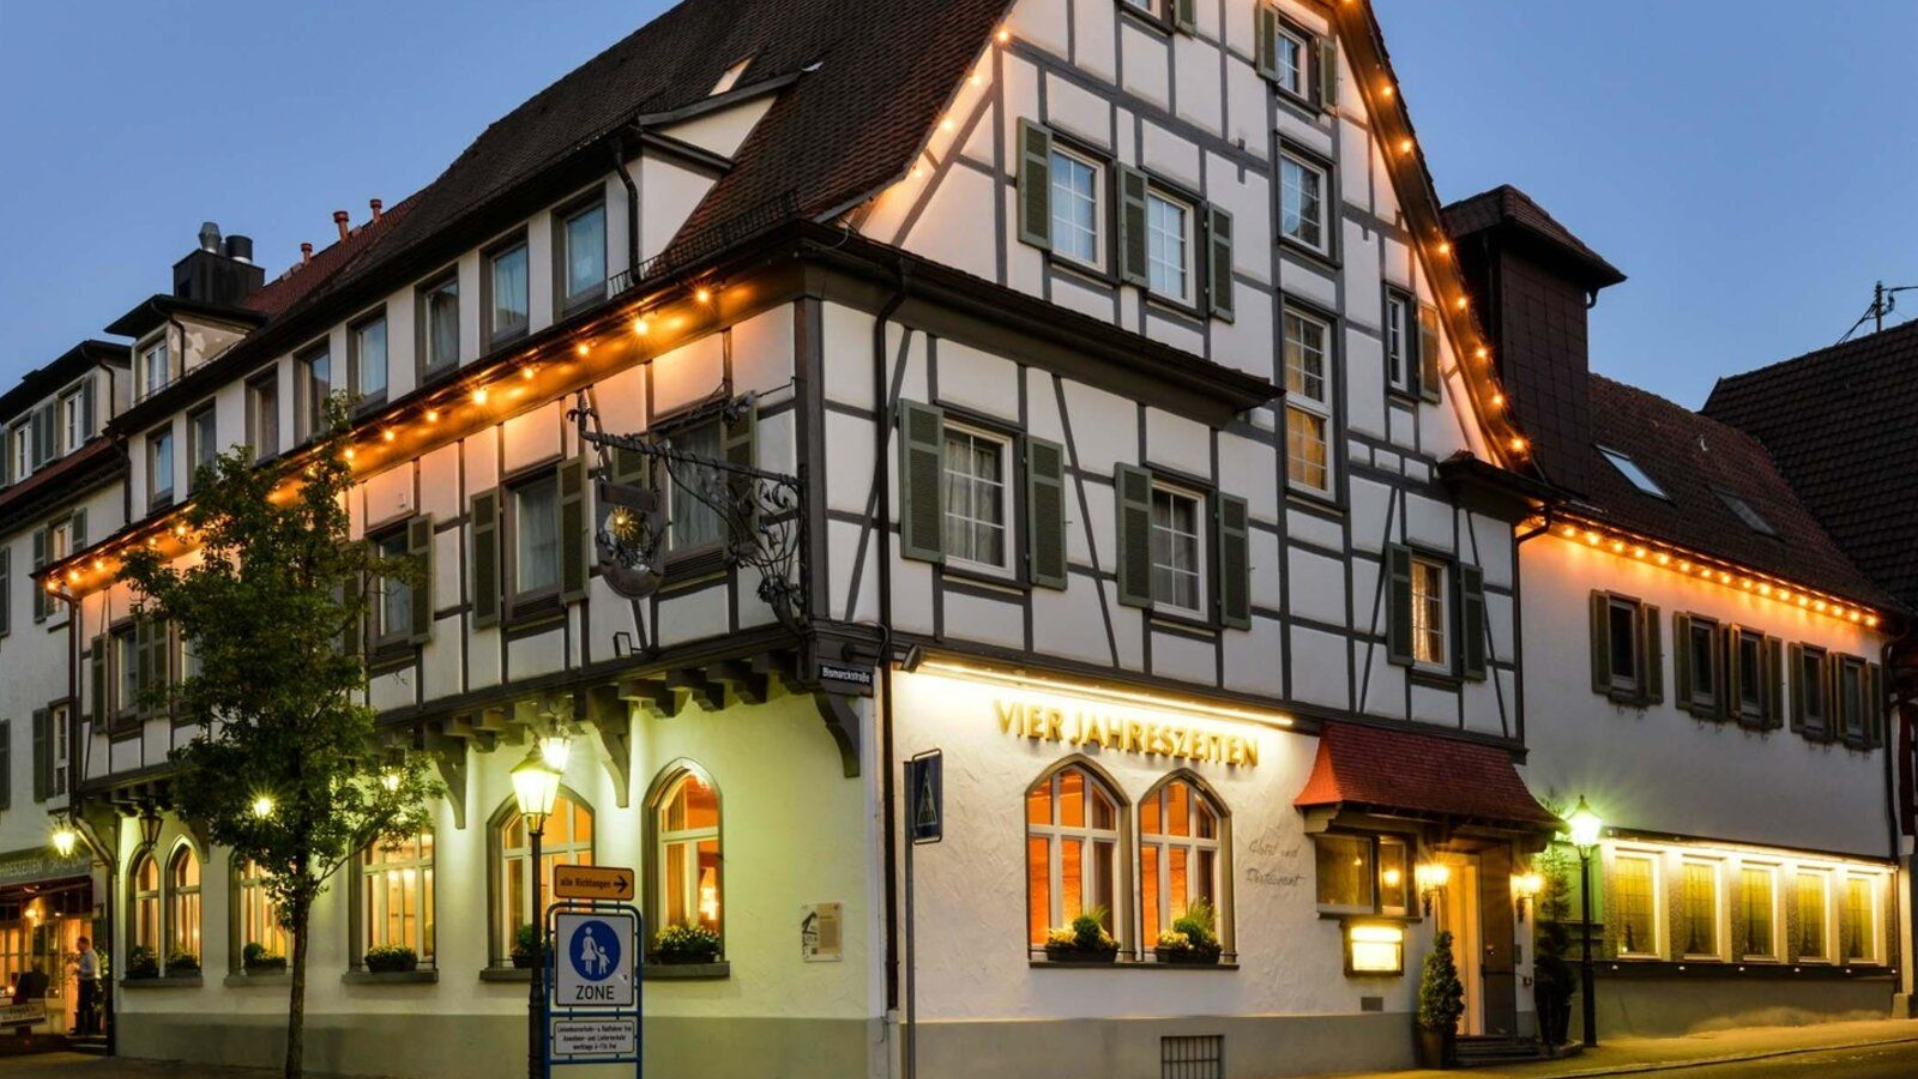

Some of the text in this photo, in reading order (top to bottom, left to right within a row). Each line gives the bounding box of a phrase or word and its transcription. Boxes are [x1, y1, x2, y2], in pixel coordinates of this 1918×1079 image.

[993, 699, 1259, 767] VIER JAHRESZEITEN
[575, 877, 611, 890] Richtungen
[576, 985, 615, 1000] ZONE
